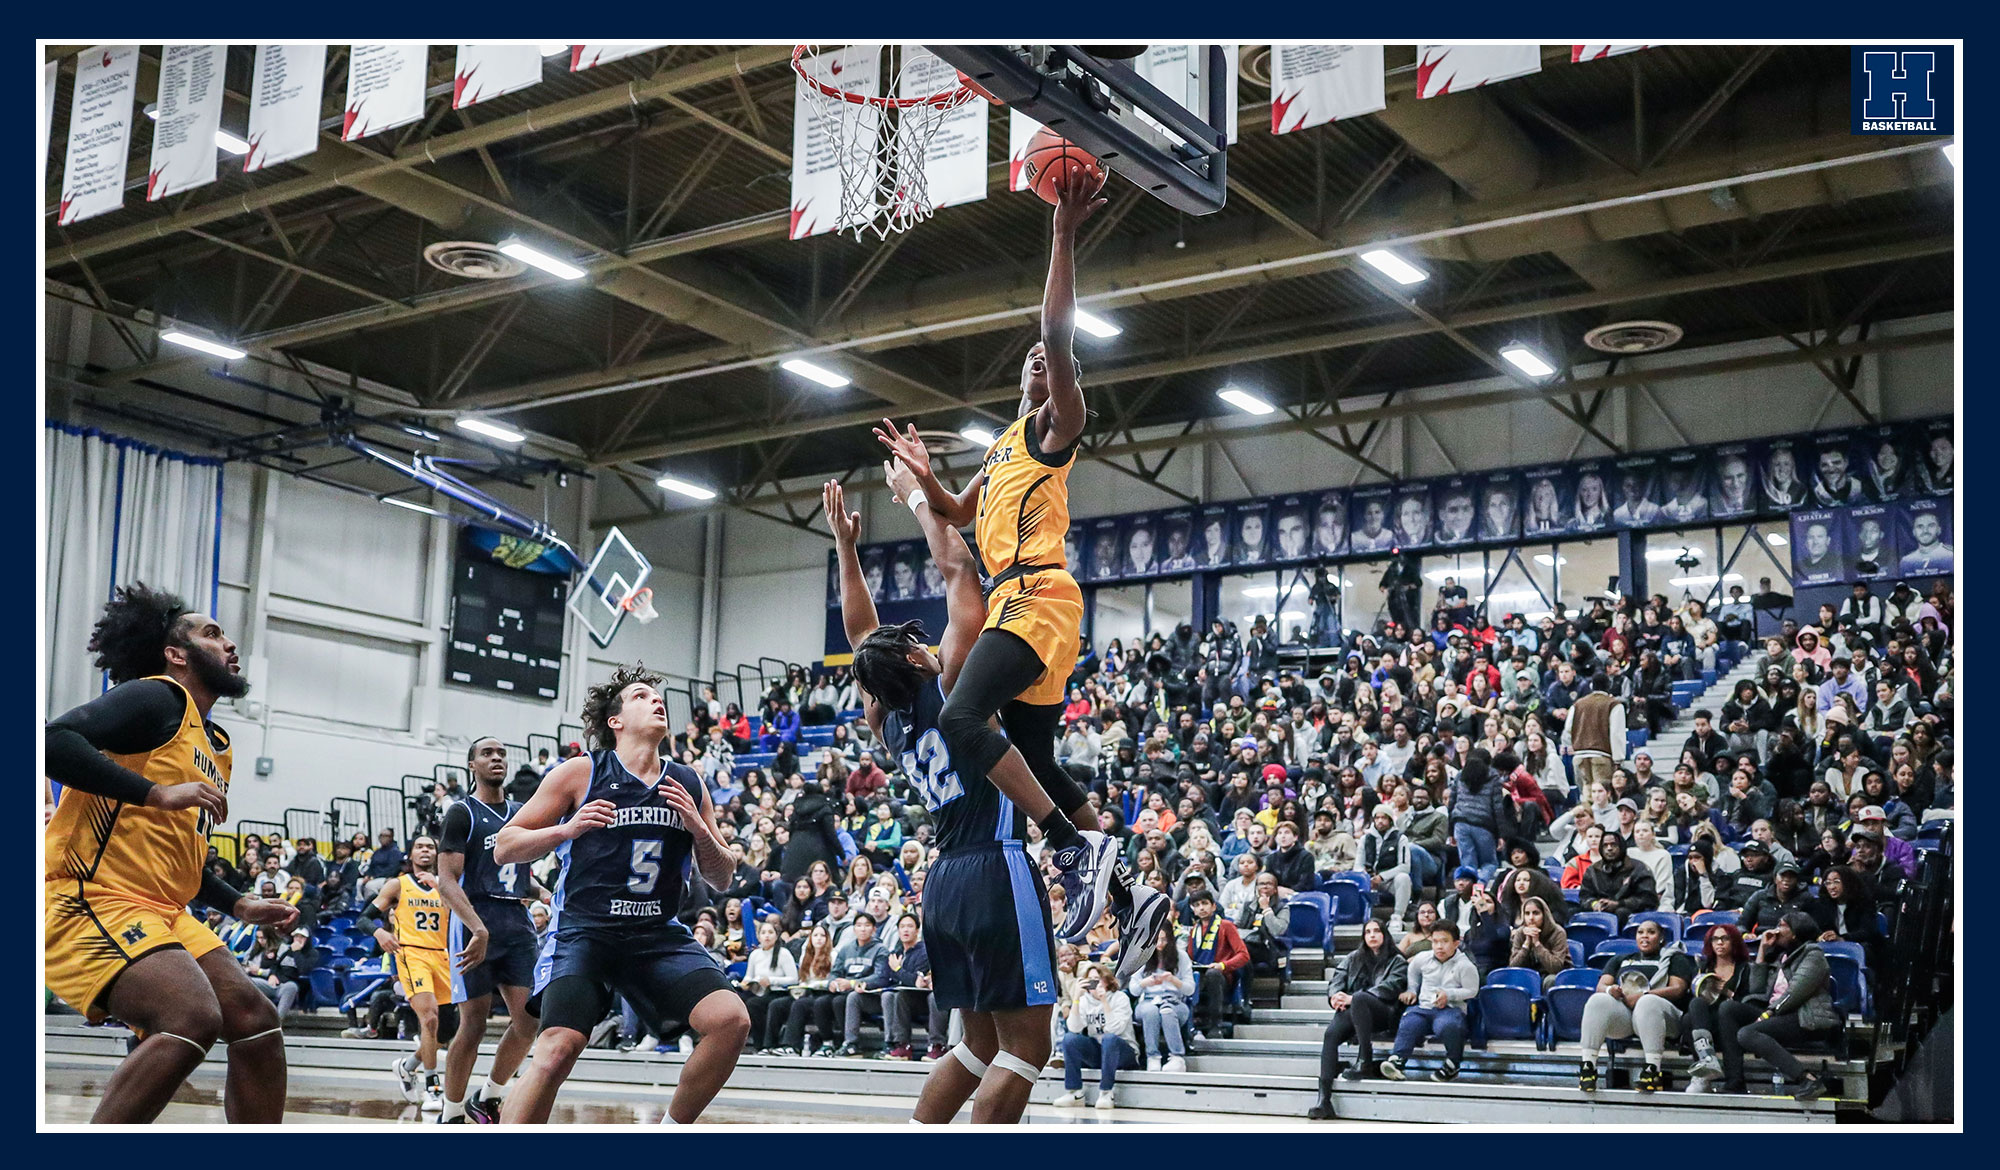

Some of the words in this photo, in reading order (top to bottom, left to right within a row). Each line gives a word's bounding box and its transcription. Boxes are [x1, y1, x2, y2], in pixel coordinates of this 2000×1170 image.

[626, 839, 665, 894] 5
[497, 863, 518, 894] 4
[408, 898, 444, 908] HUMBE
[609, 899, 662, 916] BRUINS
[415, 911, 440, 932] 23
[1034, 981, 1047, 993] 42
